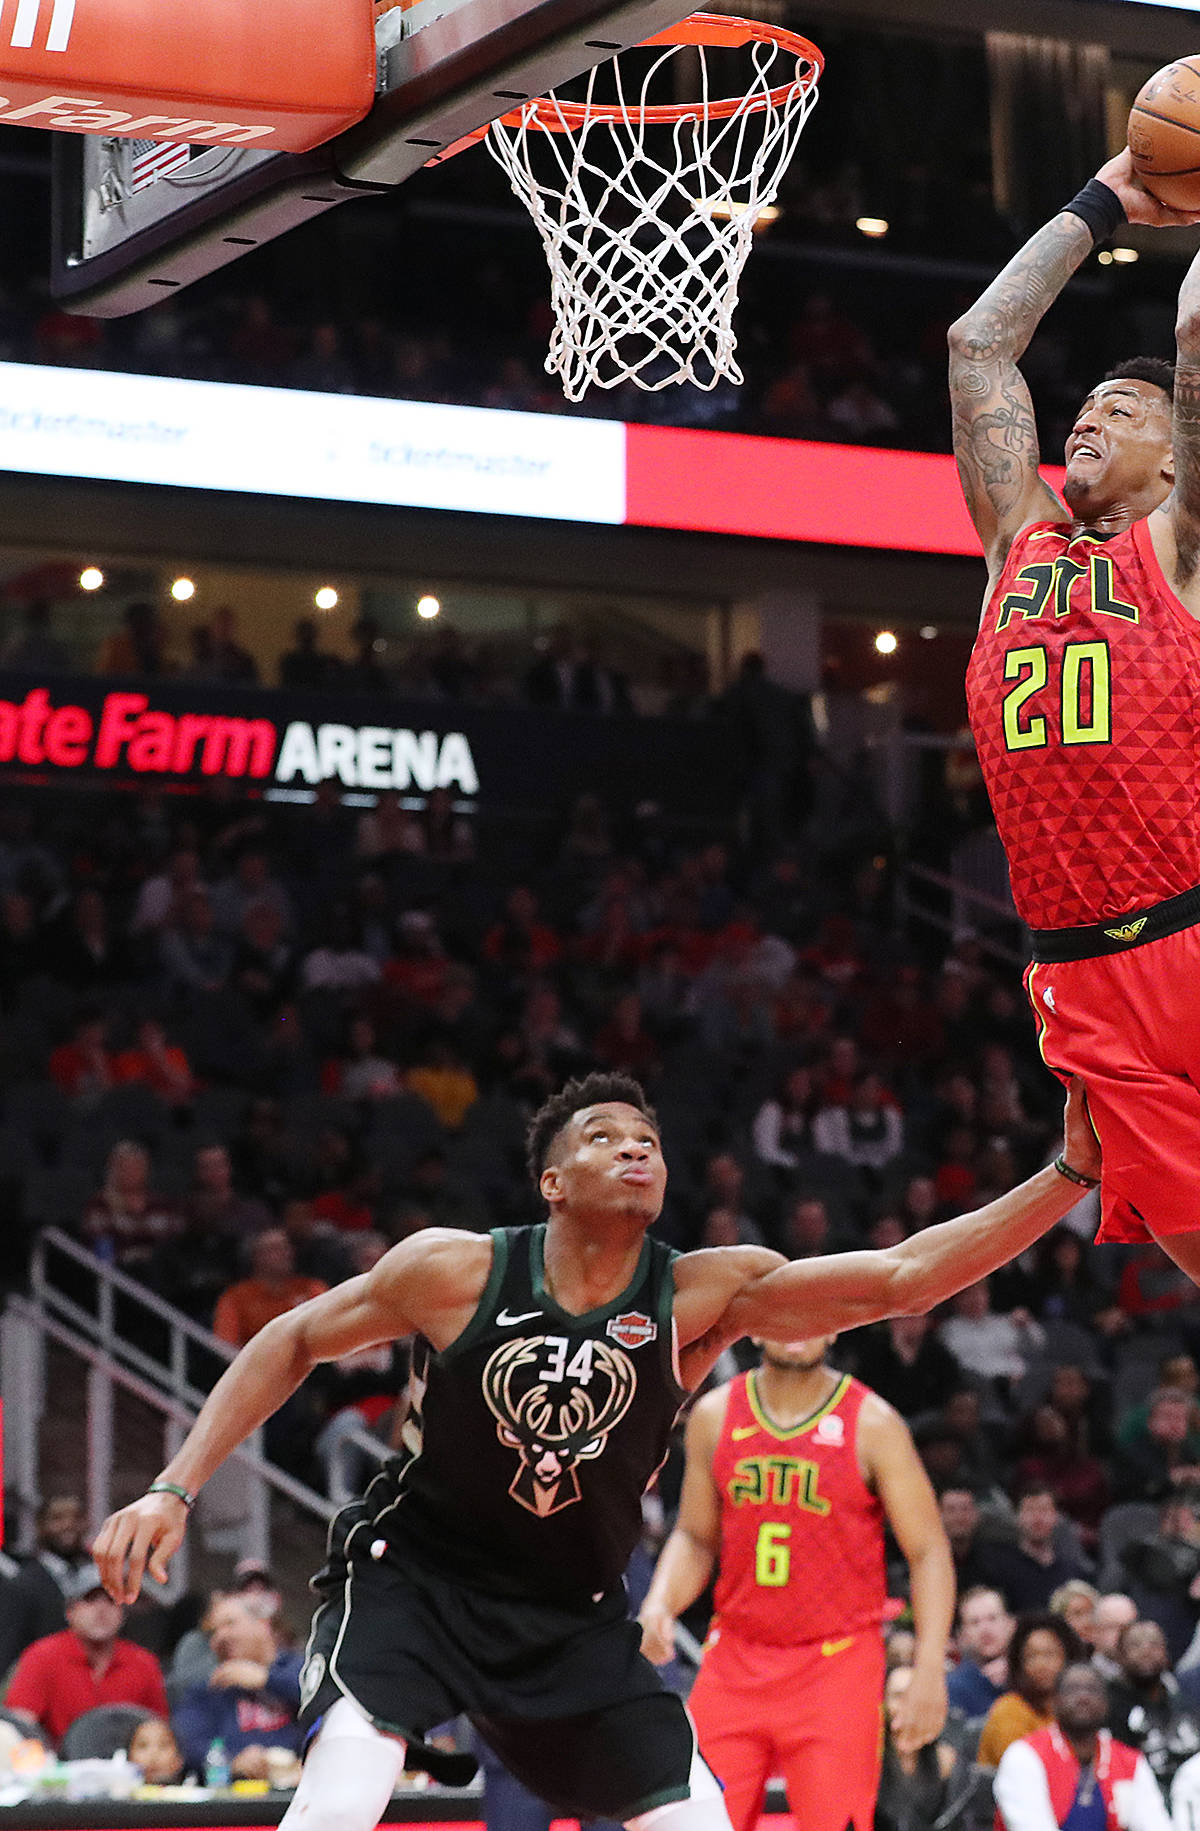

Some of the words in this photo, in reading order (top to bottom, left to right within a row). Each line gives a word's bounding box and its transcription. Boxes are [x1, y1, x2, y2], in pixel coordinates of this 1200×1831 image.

[0, 95, 276, 143] Farm
[995, 554, 1140, 633] ATL
[1003, 639, 1112, 753] 20
[95, 692, 277, 778] Farm
[275, 721, 480, 794] ARENA
[539, 1335, 594, 1386] 34
[727, 1453, 832, 1517] ATL
[756, 1522, 791, 1587] 6
